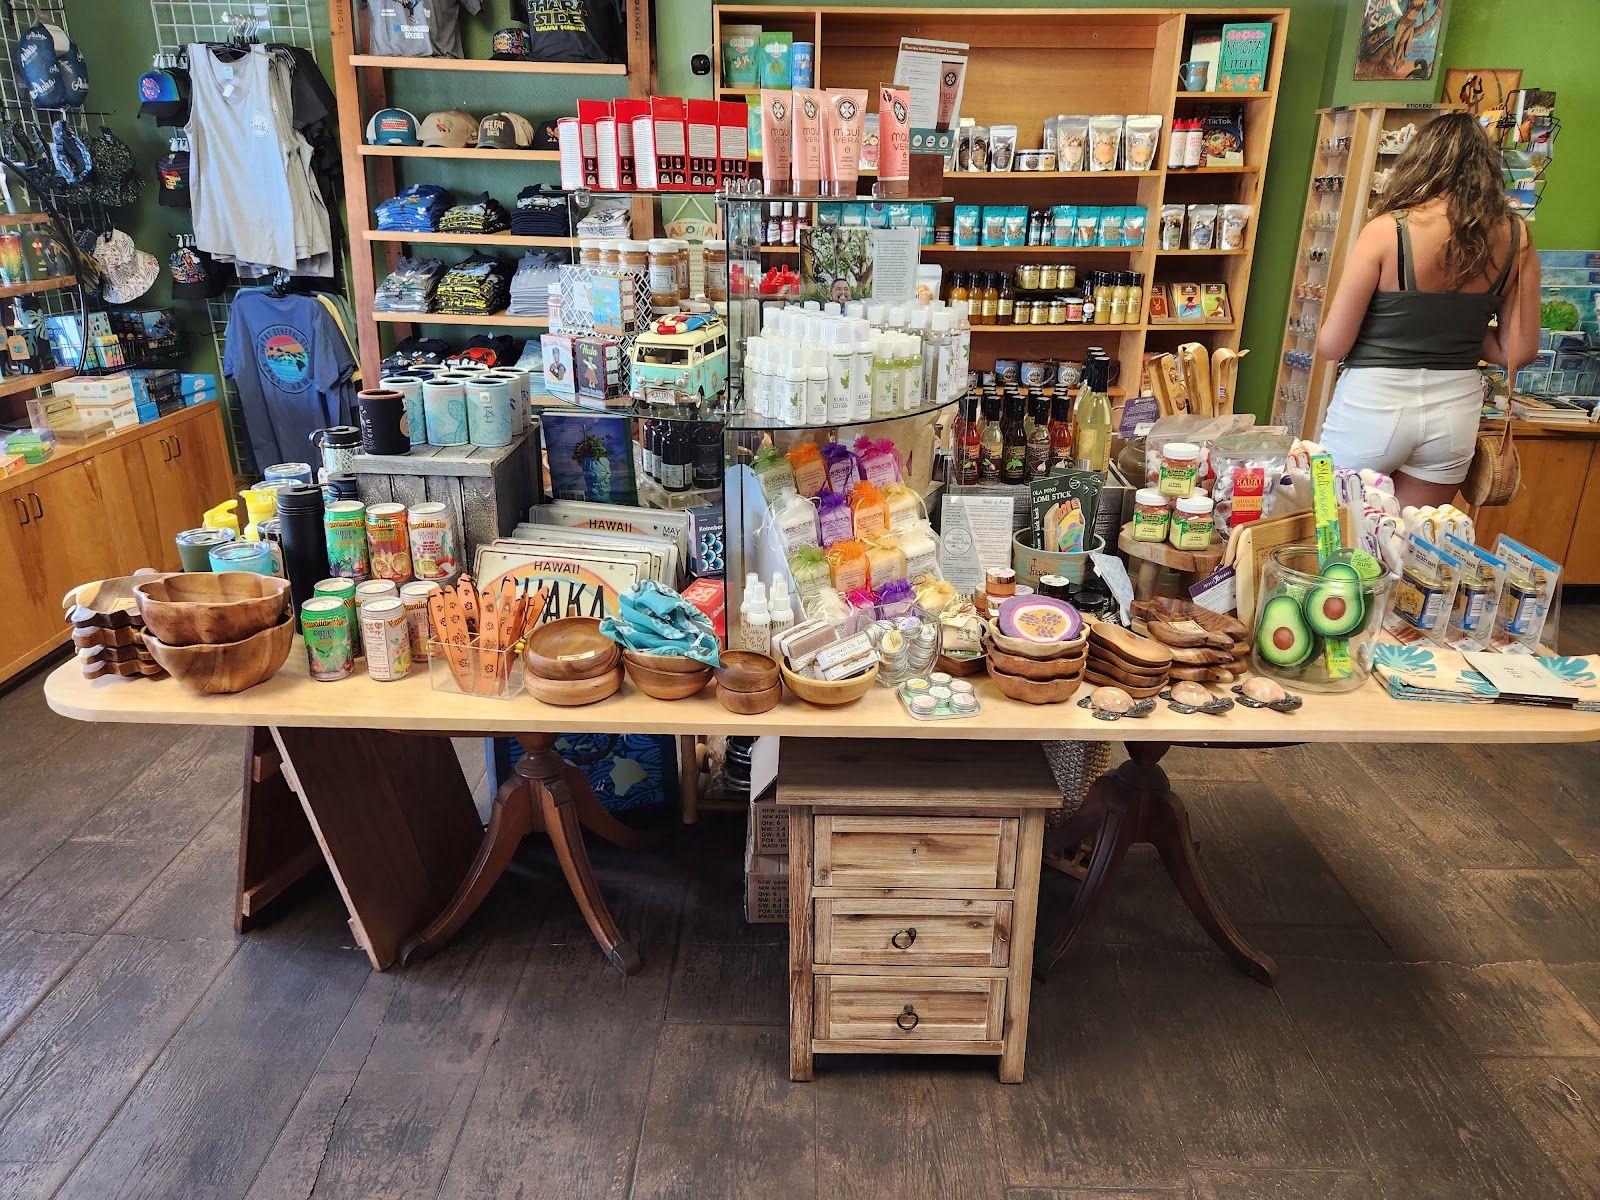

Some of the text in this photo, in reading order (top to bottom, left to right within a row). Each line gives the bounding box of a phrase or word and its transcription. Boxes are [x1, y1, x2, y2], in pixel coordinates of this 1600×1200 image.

[533, 12, 585, 26] SIDE
[833, 126, 860, 137] maui
[669, 225, 715, 238] ALOHA
[579, 343, 598, 357] Hula
[1032, 490, 1072, 504] LOMI STICK
[589, 518, 633, 533] HAWAII
[662, 526, 681, 534] MAY
[533, 560, 581, 574] HAWAII
[313, 628, 336, 636] GREEN
